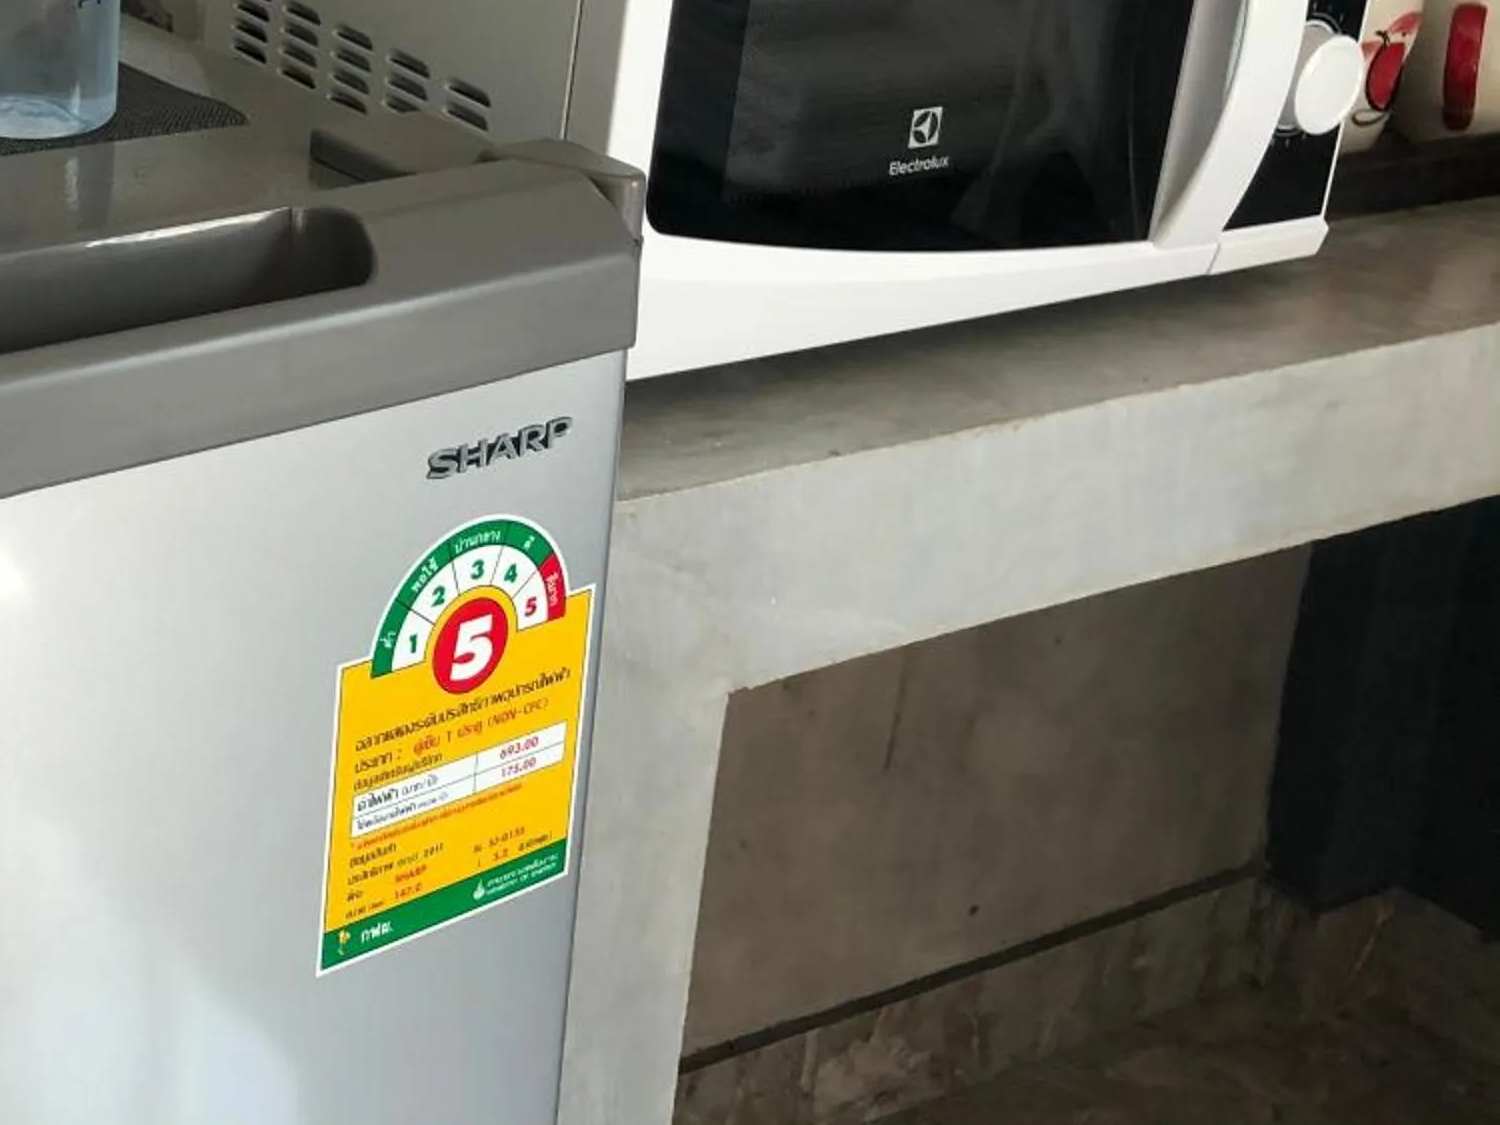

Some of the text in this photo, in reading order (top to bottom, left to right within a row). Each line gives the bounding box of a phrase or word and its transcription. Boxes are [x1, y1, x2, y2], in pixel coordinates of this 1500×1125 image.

[889, 155, 949, 176] Electrolux
[426, 416, 573, 480] SHARP
[470, 559, 485, 581] 3
[503, 562, 518, 584] 4
[432, 585, 446, 608] 2
[524, 596, 537, 617] 5
[409, 633, 418, 654] 1
[449, 613, 494, 681] 5
[500, 735, 540, 760] 693.00
